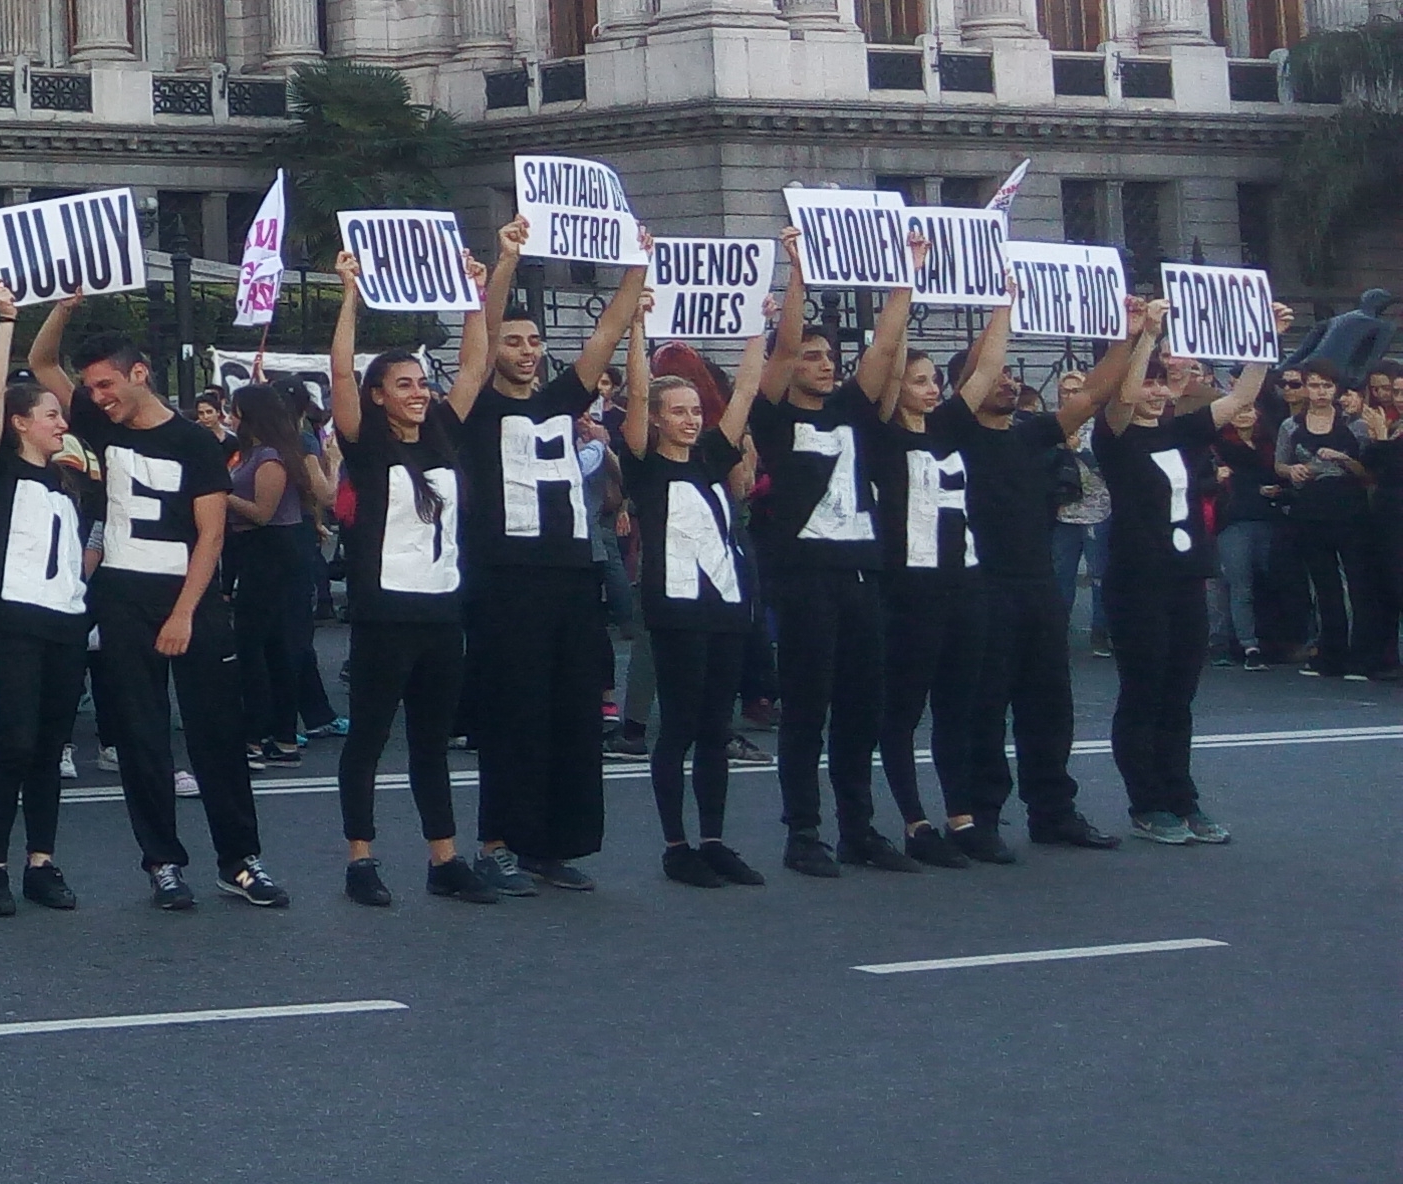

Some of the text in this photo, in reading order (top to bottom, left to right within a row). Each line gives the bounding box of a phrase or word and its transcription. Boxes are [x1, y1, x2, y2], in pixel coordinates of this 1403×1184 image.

[523, 161, 609, 210] SANTIAGO
[0, 194, 133, 303] JUJUY
[347, 218, 474, 304] CHUBUT
[550, 212, 621, 261] ESTEREO
[654, 242, 760, 287] BUENOS
[797, 193, 909, 284] NEUQUÉN
[959, 217, 1008, 297] LUIS
[670, 291, 745, 335] AIRES
[1013, 249, 1121, 337] ENTRE RÍOS
[1164, 269, 1278, 359] FORMOSA
[101, 445, 189, 577] E
[500, 414, 589, 540] A
[792, 421, 876, 541] Z
[905, 449, 980, 569] A
[1150, 448, 1192, 554] !
[664, 479, 744, 604] N
